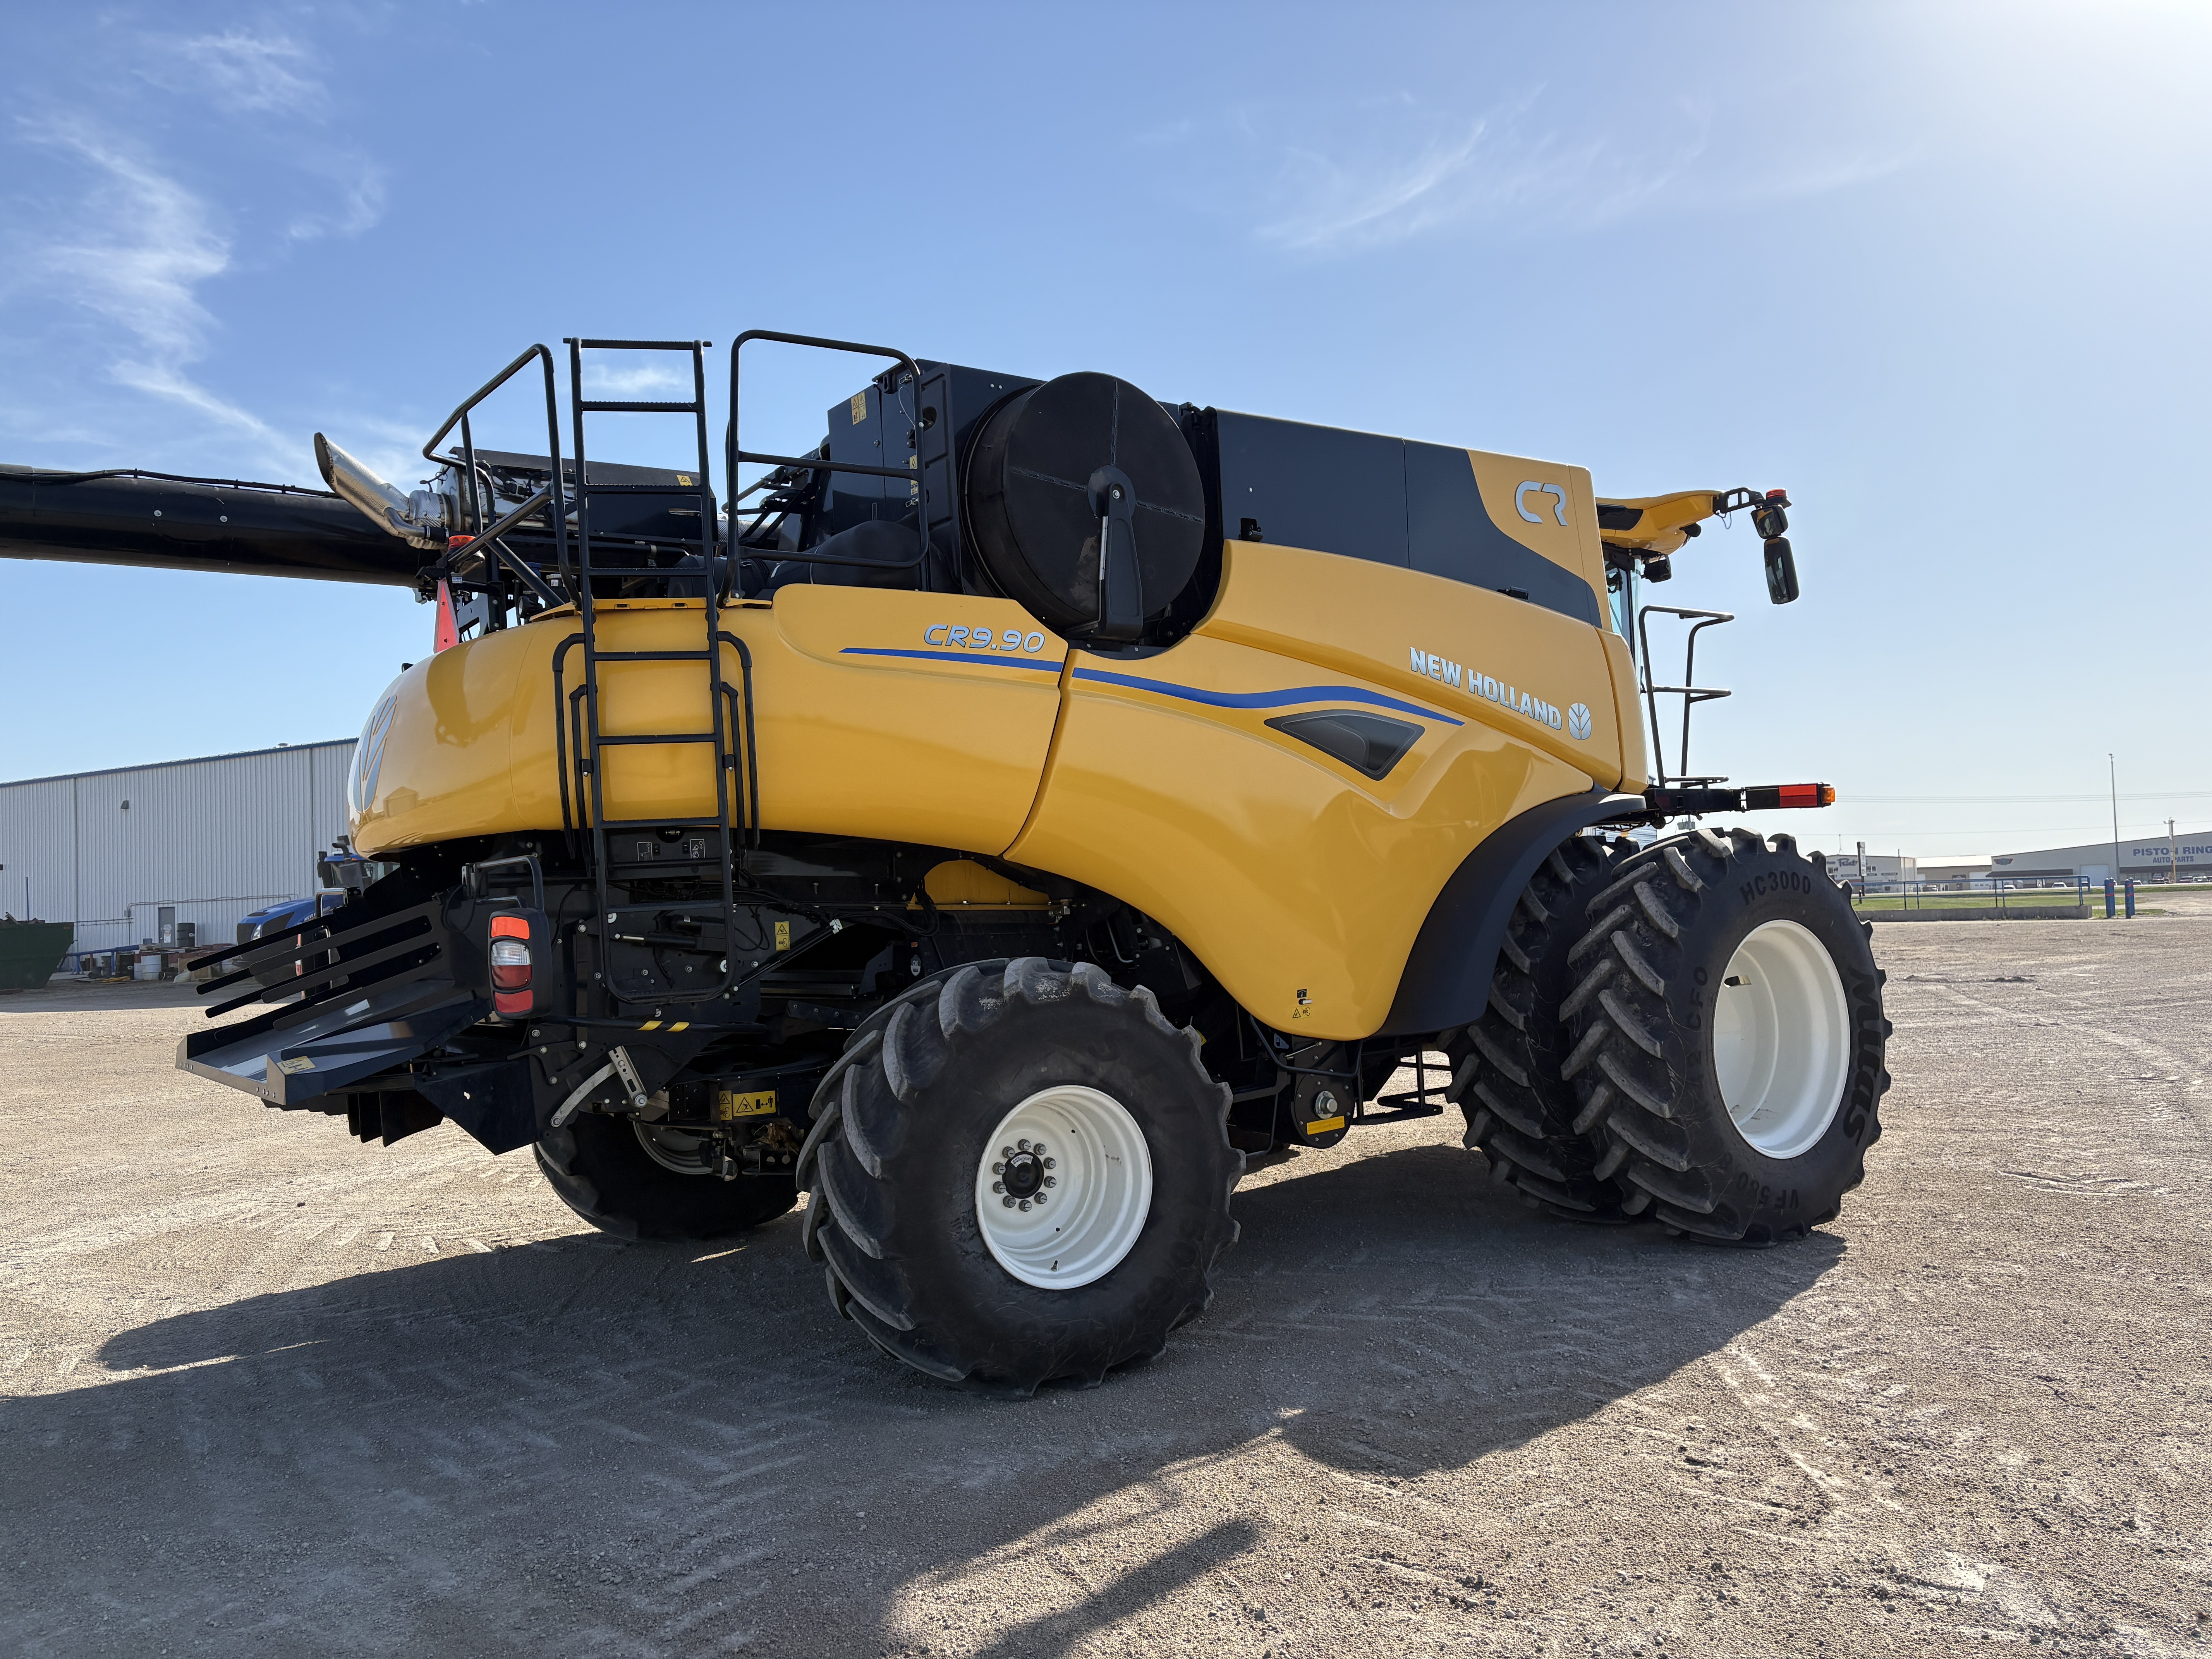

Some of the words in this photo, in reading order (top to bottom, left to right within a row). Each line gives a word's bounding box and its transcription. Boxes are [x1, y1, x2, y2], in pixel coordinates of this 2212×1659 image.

[1515, 480, 1568, 526] CR
[924, 624, 1045, 653] CR9.90
[1410, 647, 1462, 688] NEW
[1467, 669, 1562, 730] HOLLAND
[2183, 846, 2212, 854] RING
